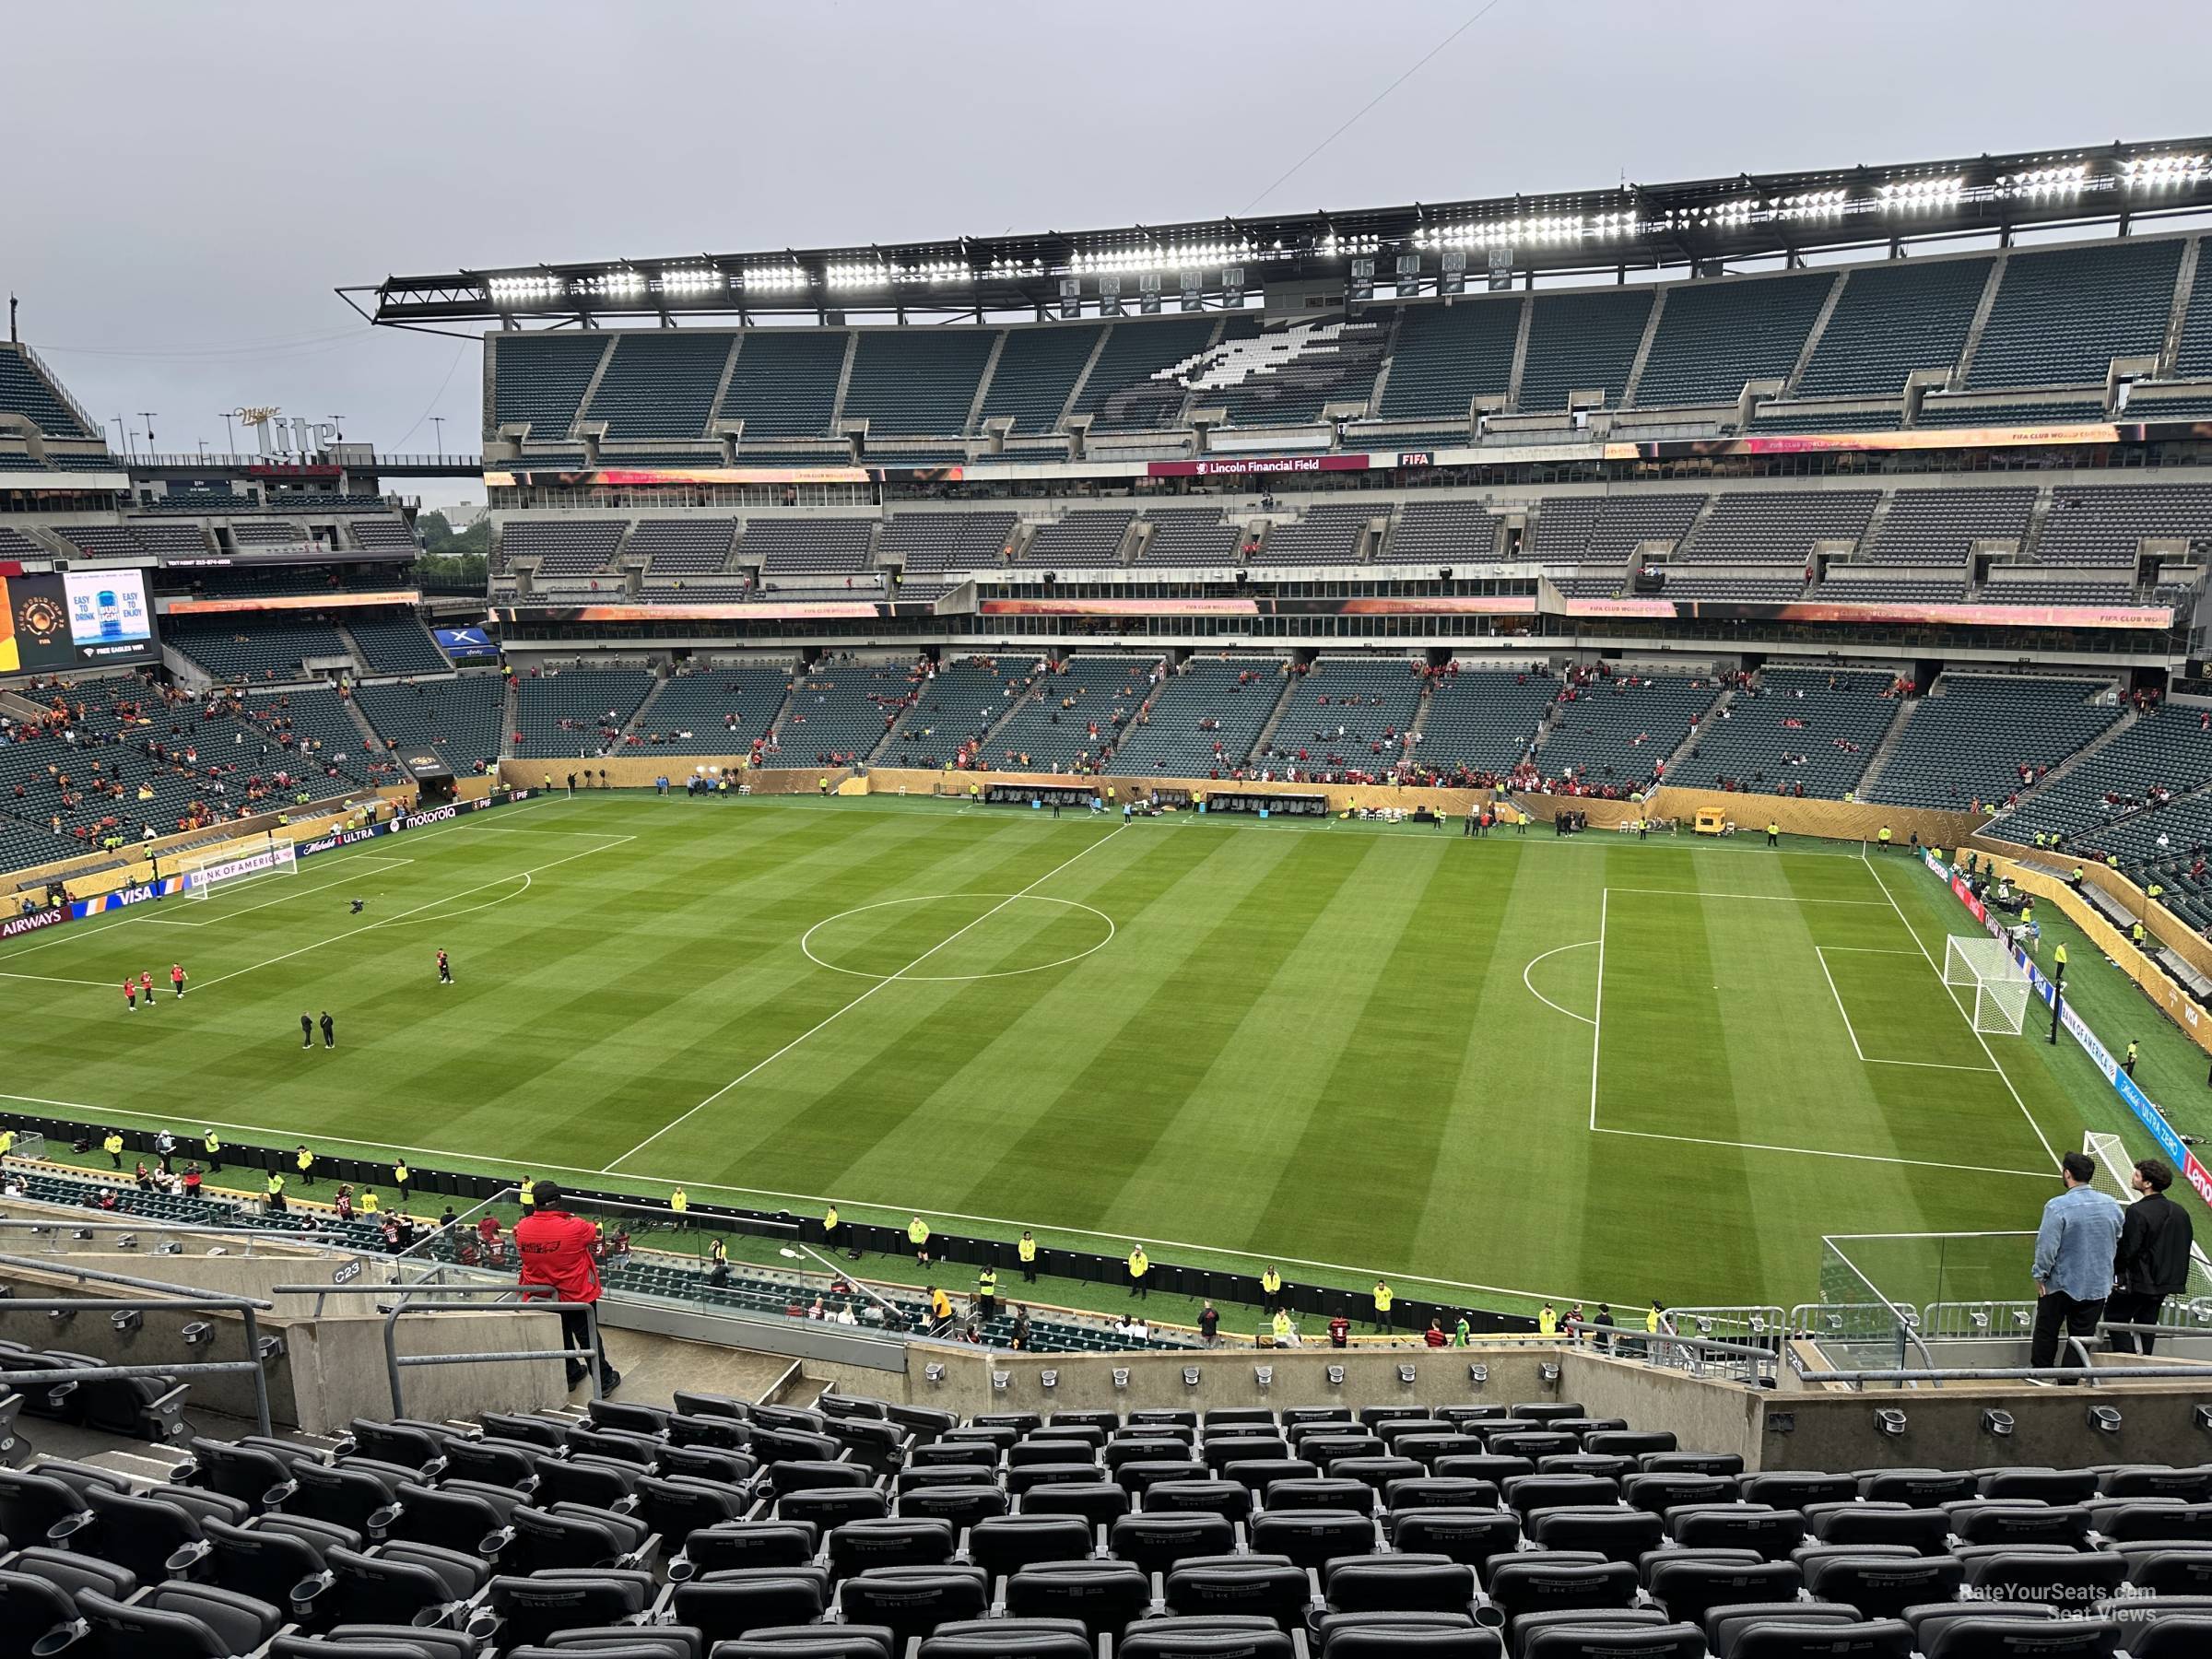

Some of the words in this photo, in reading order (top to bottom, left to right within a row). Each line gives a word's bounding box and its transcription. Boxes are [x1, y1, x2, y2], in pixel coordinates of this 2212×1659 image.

[1354, 259, 1373, 277] 15
[1224, 270, 1242, 287] 70
[233, 406, 281, 427] Miller
[254, 418, 335, 463] Lite
[1210, 463, 1245, 473] Lincoln
[1249, 461, 1292, 472] Financial
[1295, 459, 1319, 470] Field
[1403, 454, 1429, 465] FIFA
[23, 597, 48, 608] WORLD
[74, 596, 90, 605] EASY
[123, 593, 138, 601] EASY
[76, 613, 95, 621] DRINK
[79, 605, 88, 613] TO
[124, 608, 142, 618] ENJOY
[479, 798, 491, 808] PIF
[517, 790, 528, 800] PIF
[406, 806, 455, 829] motorola
[343, 829, 374, 844] ULTRA
[223, 865, 236, 875] OF
[1925, 851, 1948, 882] Hisense
[120, 886, 153, 905] VISA
[3, 910, 62, 936] AIRWAYS
[2185, 1003, 2198, 1028] VISA
[2063, 1007, 2077, 1031] BANK
[2077, 1021, 2084, 1036] OF
[2084, 1034, 2108, 1069] AMERICA
[2142, 1104, 2160, 1135] ULTRA
[2160, 1128, 2178, 1156] ZERO
[335, 1262, 359, 1283] C23
